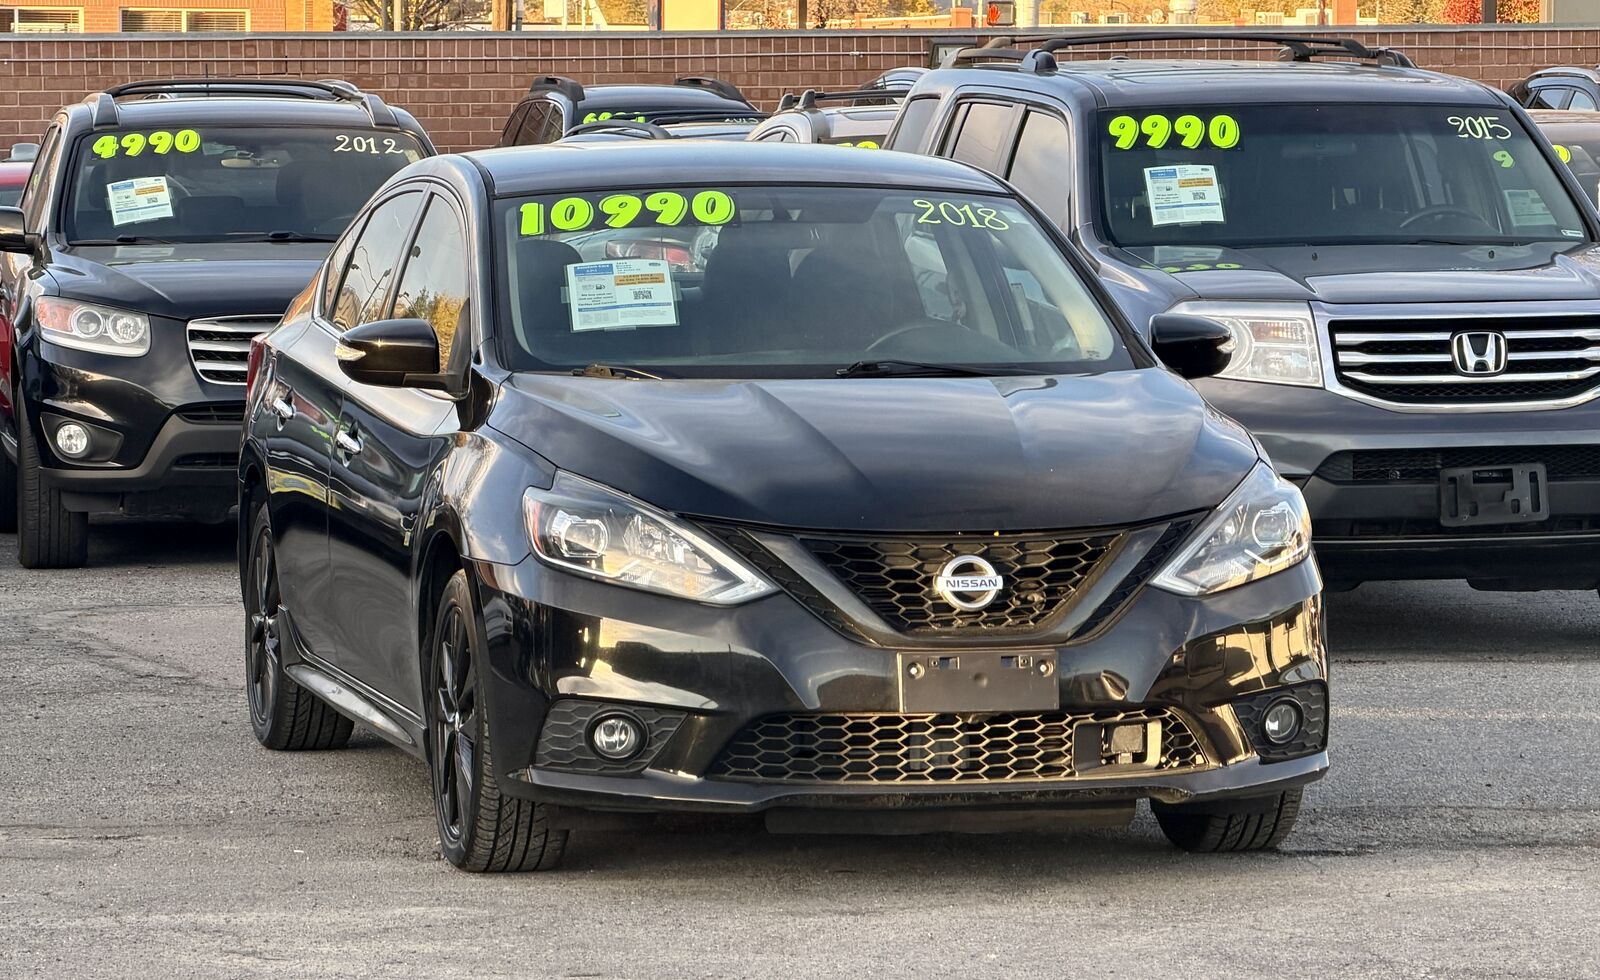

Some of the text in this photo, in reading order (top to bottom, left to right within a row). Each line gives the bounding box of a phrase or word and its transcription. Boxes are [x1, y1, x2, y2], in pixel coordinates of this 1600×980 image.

[1108, 114, 1241, 150] 9990
[1447, 116, 1512, 139] 2015
[92, 129, 201, 159] 4990
[333, 134, 404, 154] 2012
[519, 190, 736, 236] 10990
[913, 199, 1010, 231] 2018
[945, 578, 998, 588] NISSAN
